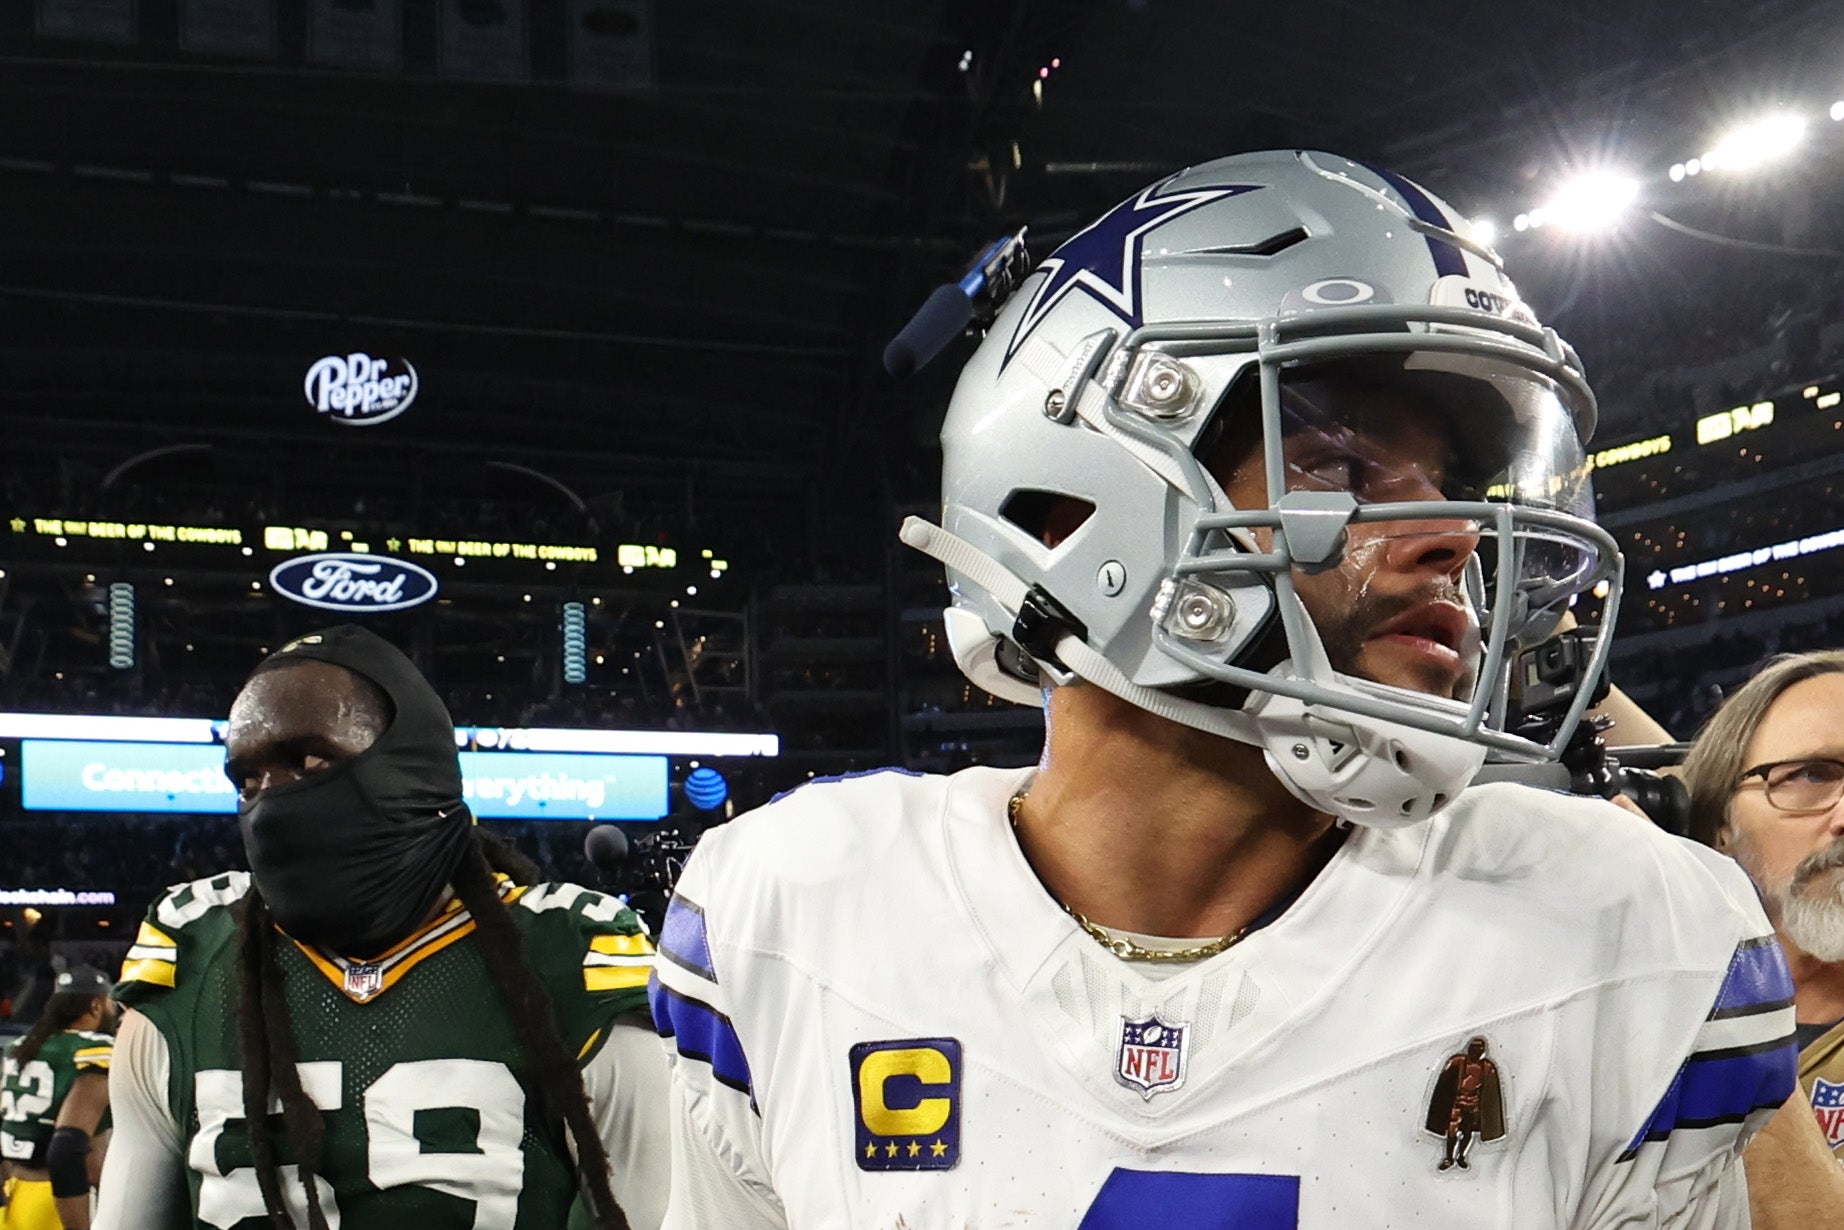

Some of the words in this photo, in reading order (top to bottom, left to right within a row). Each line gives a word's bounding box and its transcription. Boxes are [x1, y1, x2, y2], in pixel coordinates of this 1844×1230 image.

[304, 355, 411, 416] Pepper
[347, 352, 388, 385] Dr
[1595, 435, 1672, 467] COWBOYS
[302, 560, 406, 603] Ford
[82, 763, 234, 794] Connecti
[462, 773, 605, 808] verything
[1125, 1047, 1174, 1083] NFL
[859, 1047, 952, 1136] C
